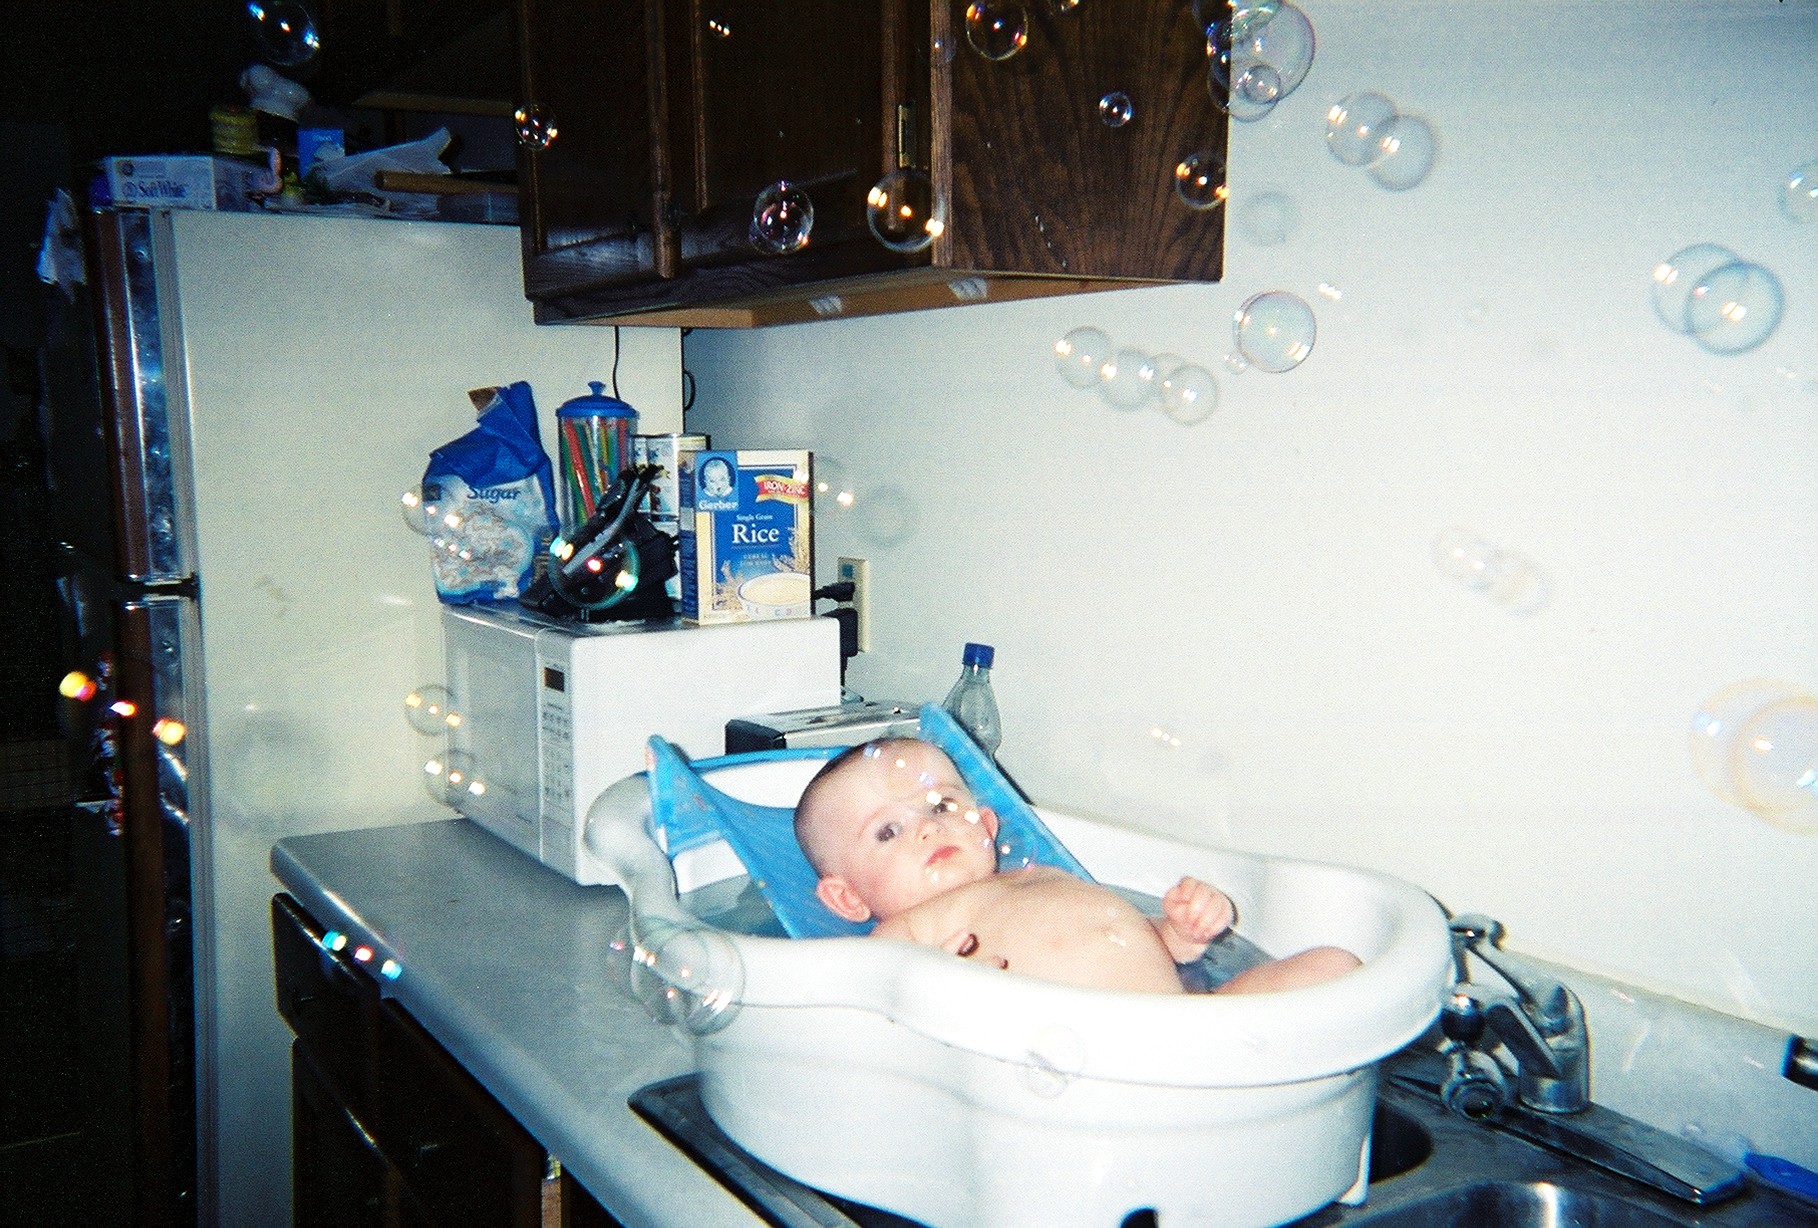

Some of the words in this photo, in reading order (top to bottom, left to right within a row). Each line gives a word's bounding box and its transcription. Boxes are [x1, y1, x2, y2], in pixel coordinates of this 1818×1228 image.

[467, 486, 521, 504] Sugar
[699, 500, 738, 511] Gerber
[731, 523, 780, 544] Rice
